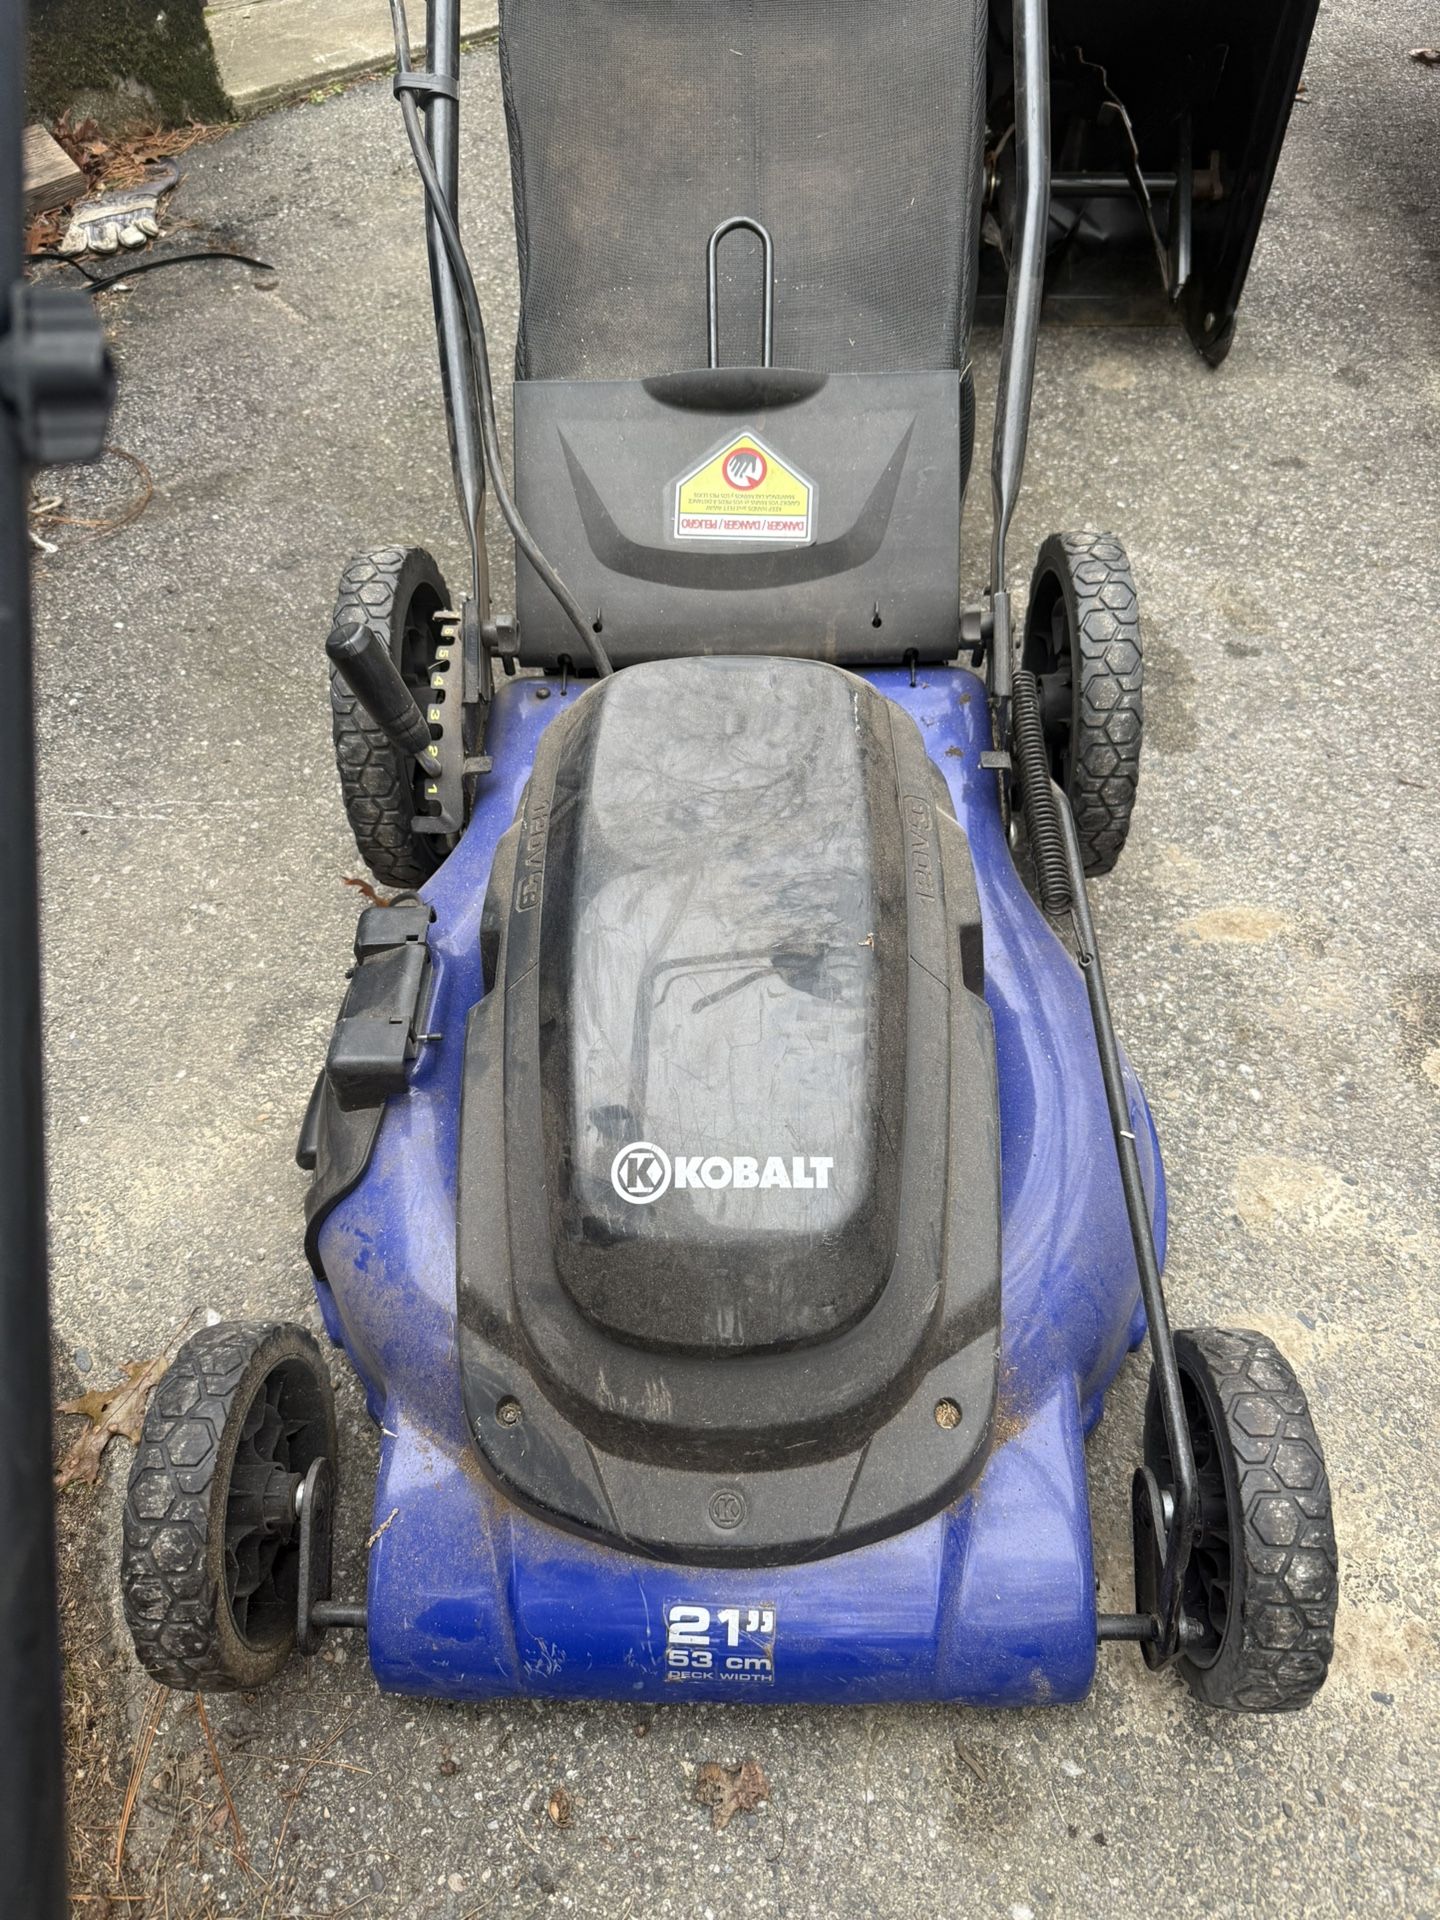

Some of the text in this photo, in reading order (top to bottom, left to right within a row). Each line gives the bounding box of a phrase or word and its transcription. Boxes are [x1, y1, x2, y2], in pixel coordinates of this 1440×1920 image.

[682, 519, 718, 529] PELIGRO
[724, 520, 761, 530] DANGER
[767, 521, 804, 531] DANGER
[445, 627, 454, 636] 6
[439, 649, 449, 658] 5
[433, 676, 444, 686] 4
[430, 709, 440, 720] 3
[428, 746, 438, 757] 2
[427, 784, 438, 794] 1
[674, 1156, 834, 1189] KOBALT
[668, 1649, 772, 1671] 53 cm
[668, 1670, 773, 1682] DECK WIDTH
